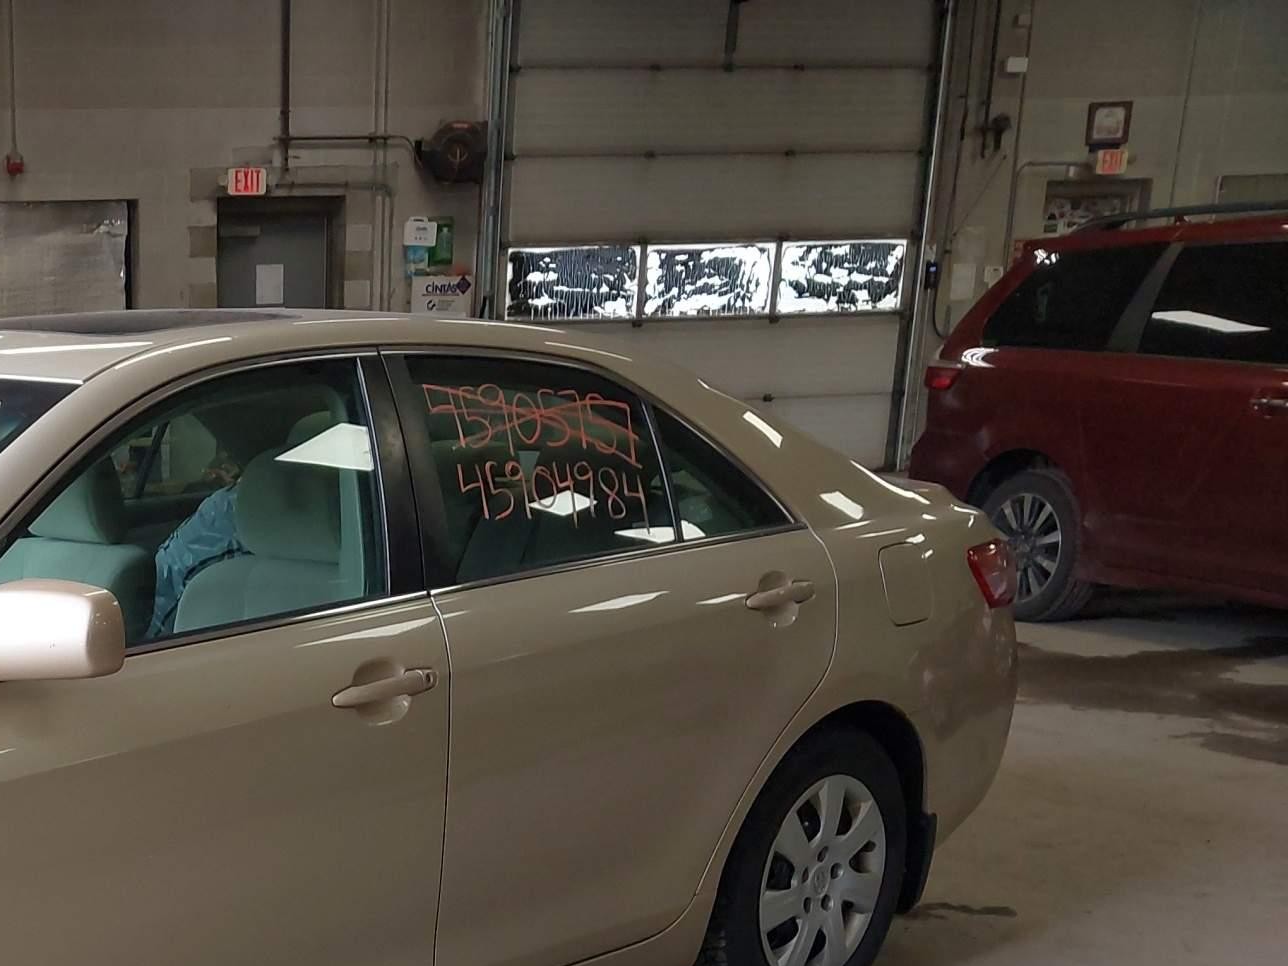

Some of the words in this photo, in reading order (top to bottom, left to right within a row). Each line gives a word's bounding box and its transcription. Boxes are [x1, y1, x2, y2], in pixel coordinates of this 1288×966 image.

[234, 169, 261, 194] EXIT
[425, 280, 457, 294] CINTAS
[456, 460, 651, 536] 45904984
